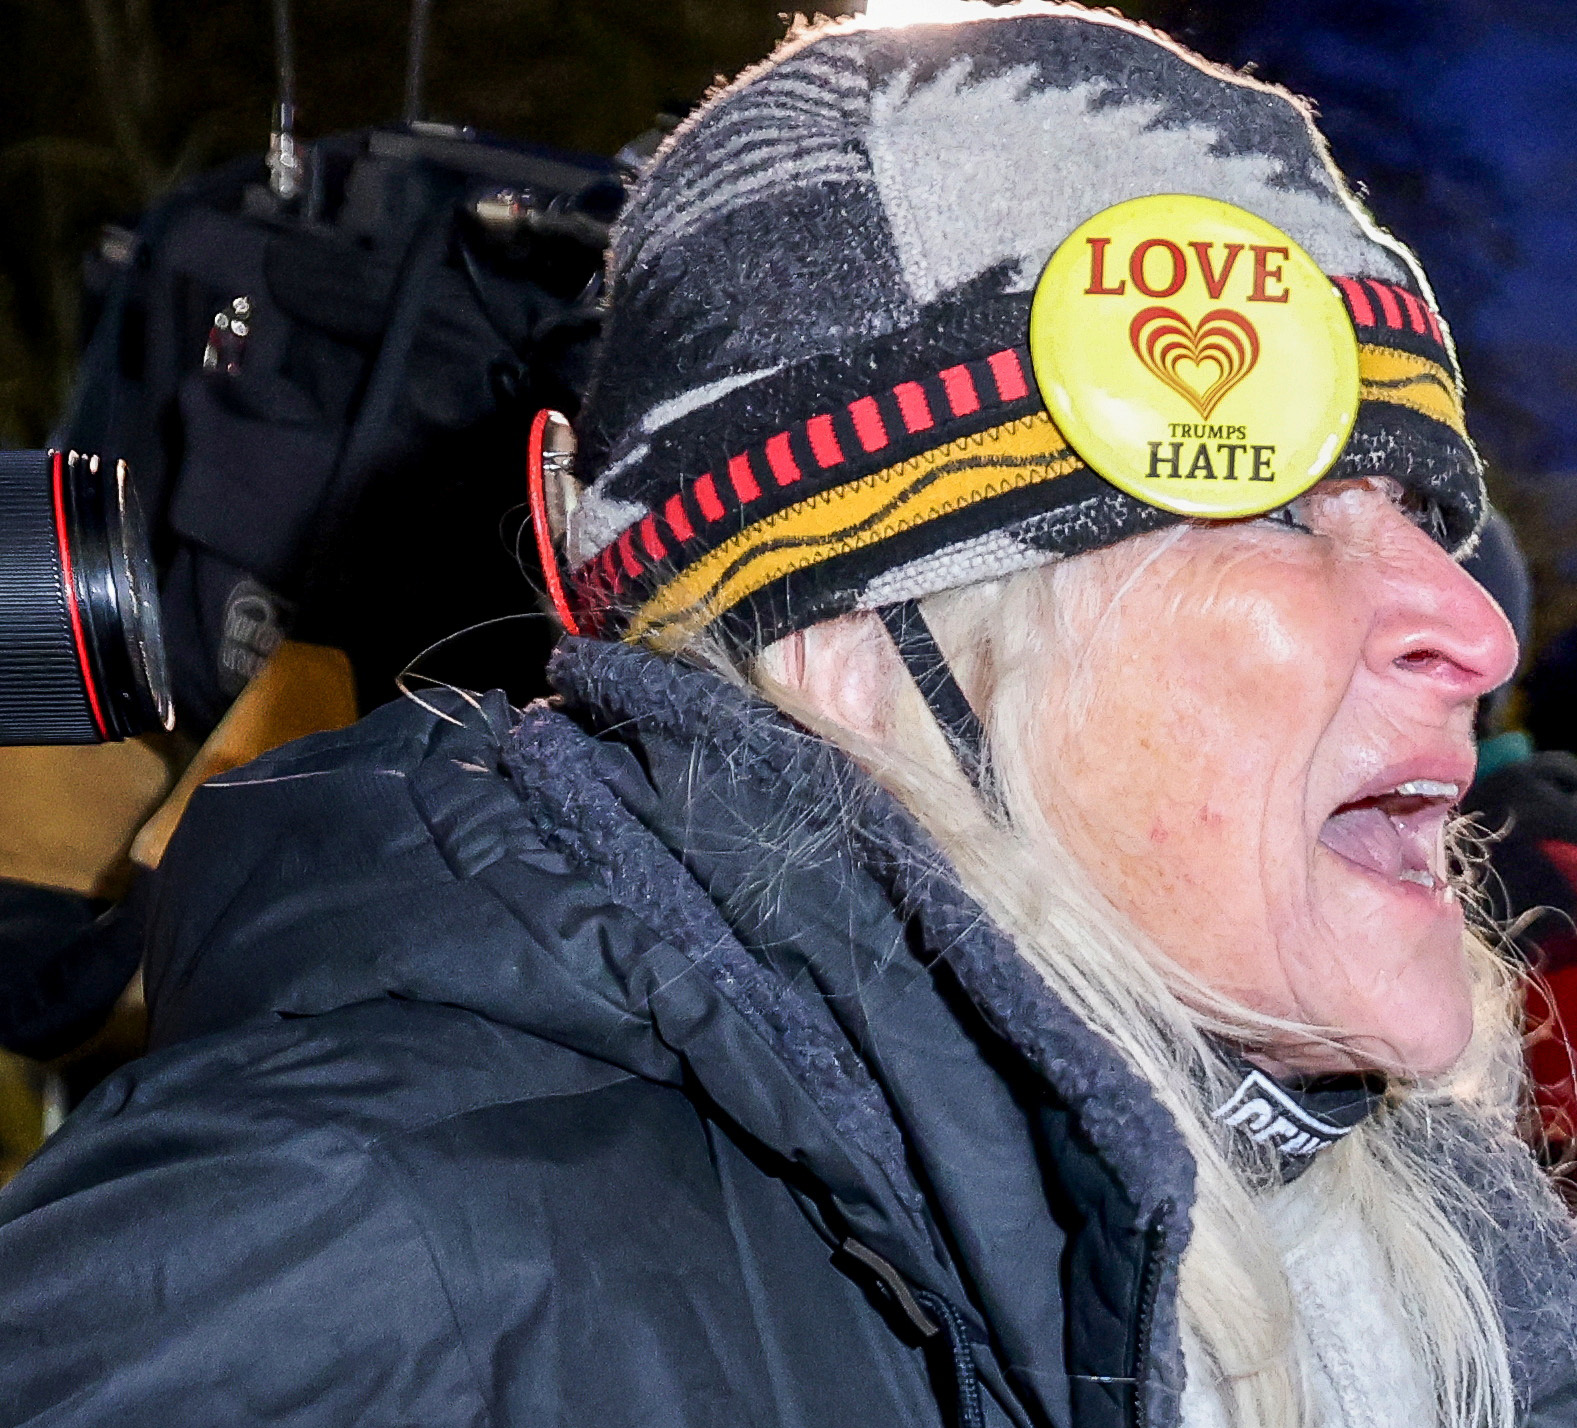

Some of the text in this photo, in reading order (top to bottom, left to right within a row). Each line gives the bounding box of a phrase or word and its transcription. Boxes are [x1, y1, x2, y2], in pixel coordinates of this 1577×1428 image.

[1084, 237, 1290, 304] LOVE
[1168, 423, 1247, 440] TRUMPS
[1145, 441, 1276, 482] HATE
